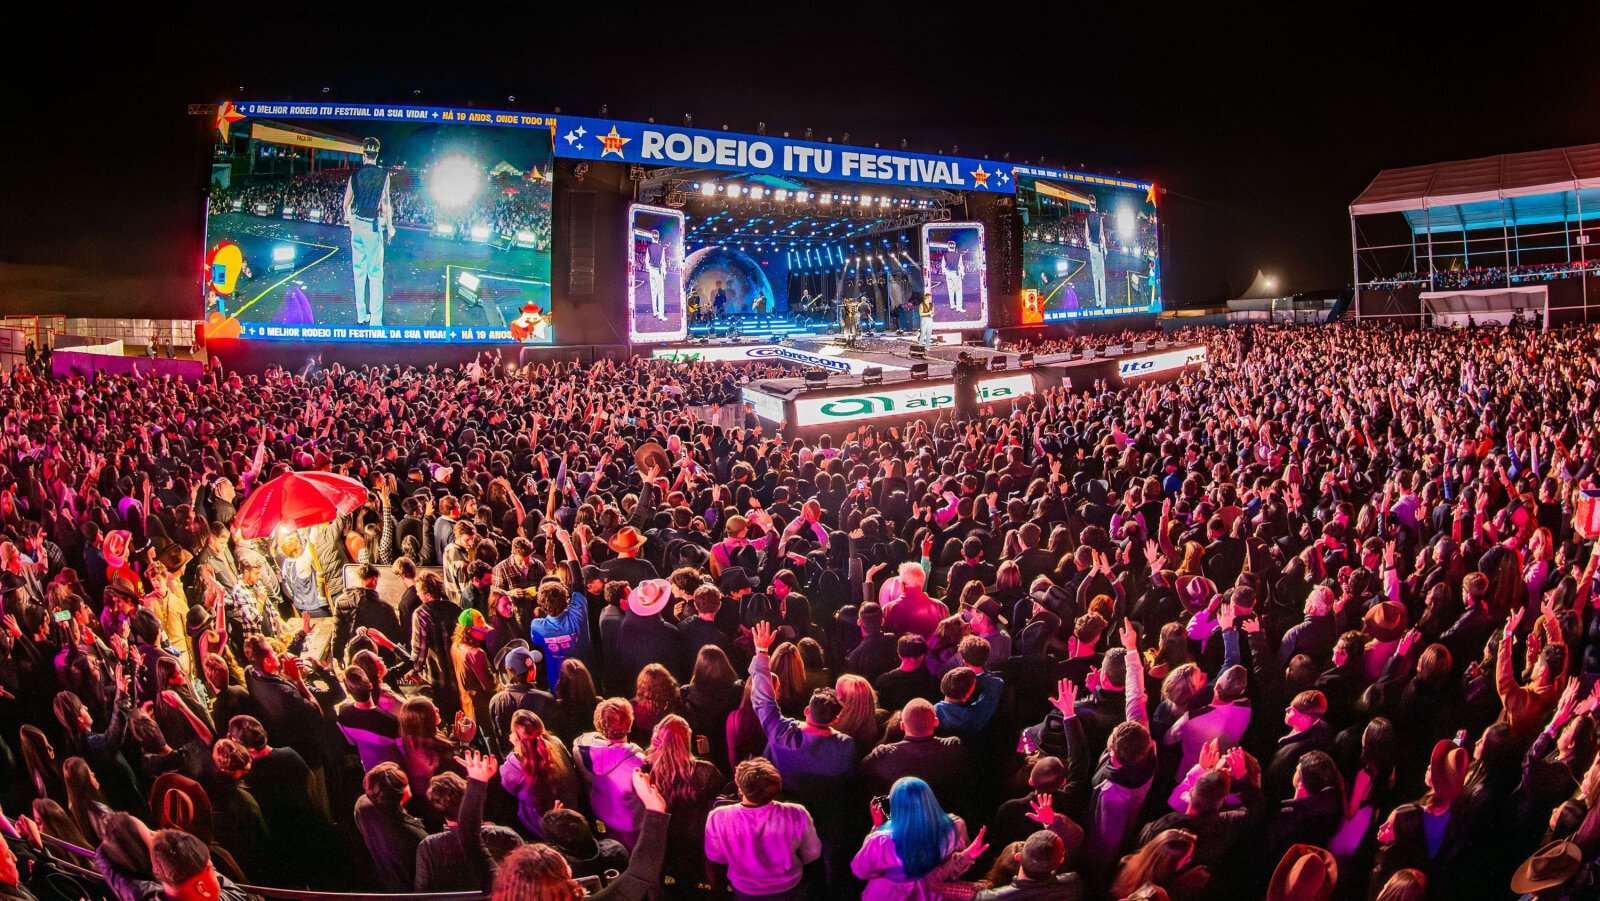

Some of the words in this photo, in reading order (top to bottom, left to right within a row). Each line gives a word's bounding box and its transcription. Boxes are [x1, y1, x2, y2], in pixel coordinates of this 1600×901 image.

[256, 105, 288, 115] MELHOR
[290, 106, 318, 115] RODEIO
[320, 106, 333, 115] ITU
[334, 107, 372, 117] FESTIVAL
[373, 108, 385, 117] DA
[387, 109, 404, 118] SUA
[406, 109, 428, 119] VIDA!
[442, 109, 454, 120] HÁ
[456, 112, 467, 121] 19
[468, 113, 494, 123] ANOS,
[496, 115, 518, 124] ONDE
[520, 116, 543, 125] TODO
[604, 136, 623, 150] ITU
[641, 130, 774, 169] RODEIO
[783, 145, 833, 174] ITU
[841, 151, 965, 186] FESTIVAL
[258, 327, 265, 336] O
[267, 327, 299, 337] MELHOR
[302, 328, 331, 338] RODEIO
[333, 328, 346, 338] ITU
[349, 329, 388, 339] FESTIVAL
[390, 330, 401, 339] DA
[404, 330, 421, 339] SUA
[423, 330, 446, 339] VIDA!
[461, 328, 474, 339] HÁ
[476, 330, 487, 339] 19
[746, 345, 852, 371] Cobrecom
[905, 386, 1012, 408] apia
